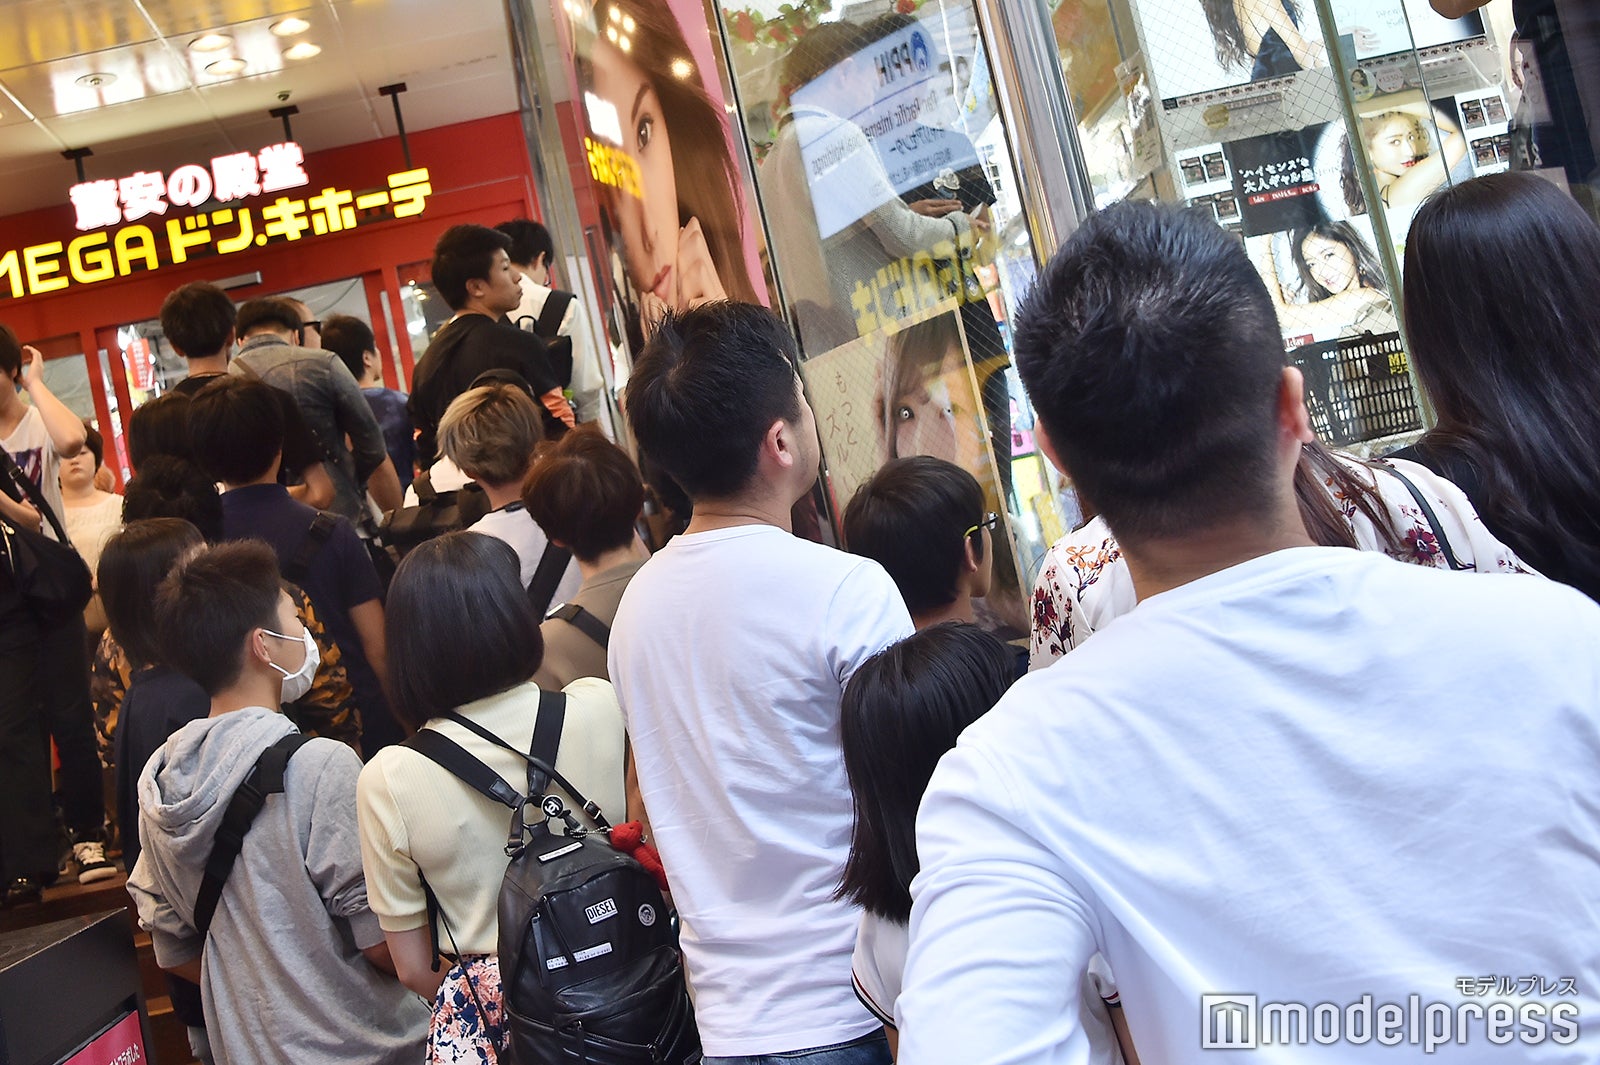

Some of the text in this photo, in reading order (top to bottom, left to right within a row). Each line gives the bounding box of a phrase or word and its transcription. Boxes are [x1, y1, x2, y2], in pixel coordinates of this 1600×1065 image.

[69, 141, 309, 231] 驚安の殿堂
[835, 371, 858, 445] もっと
[586, 899, 616, 920] DIESEL
